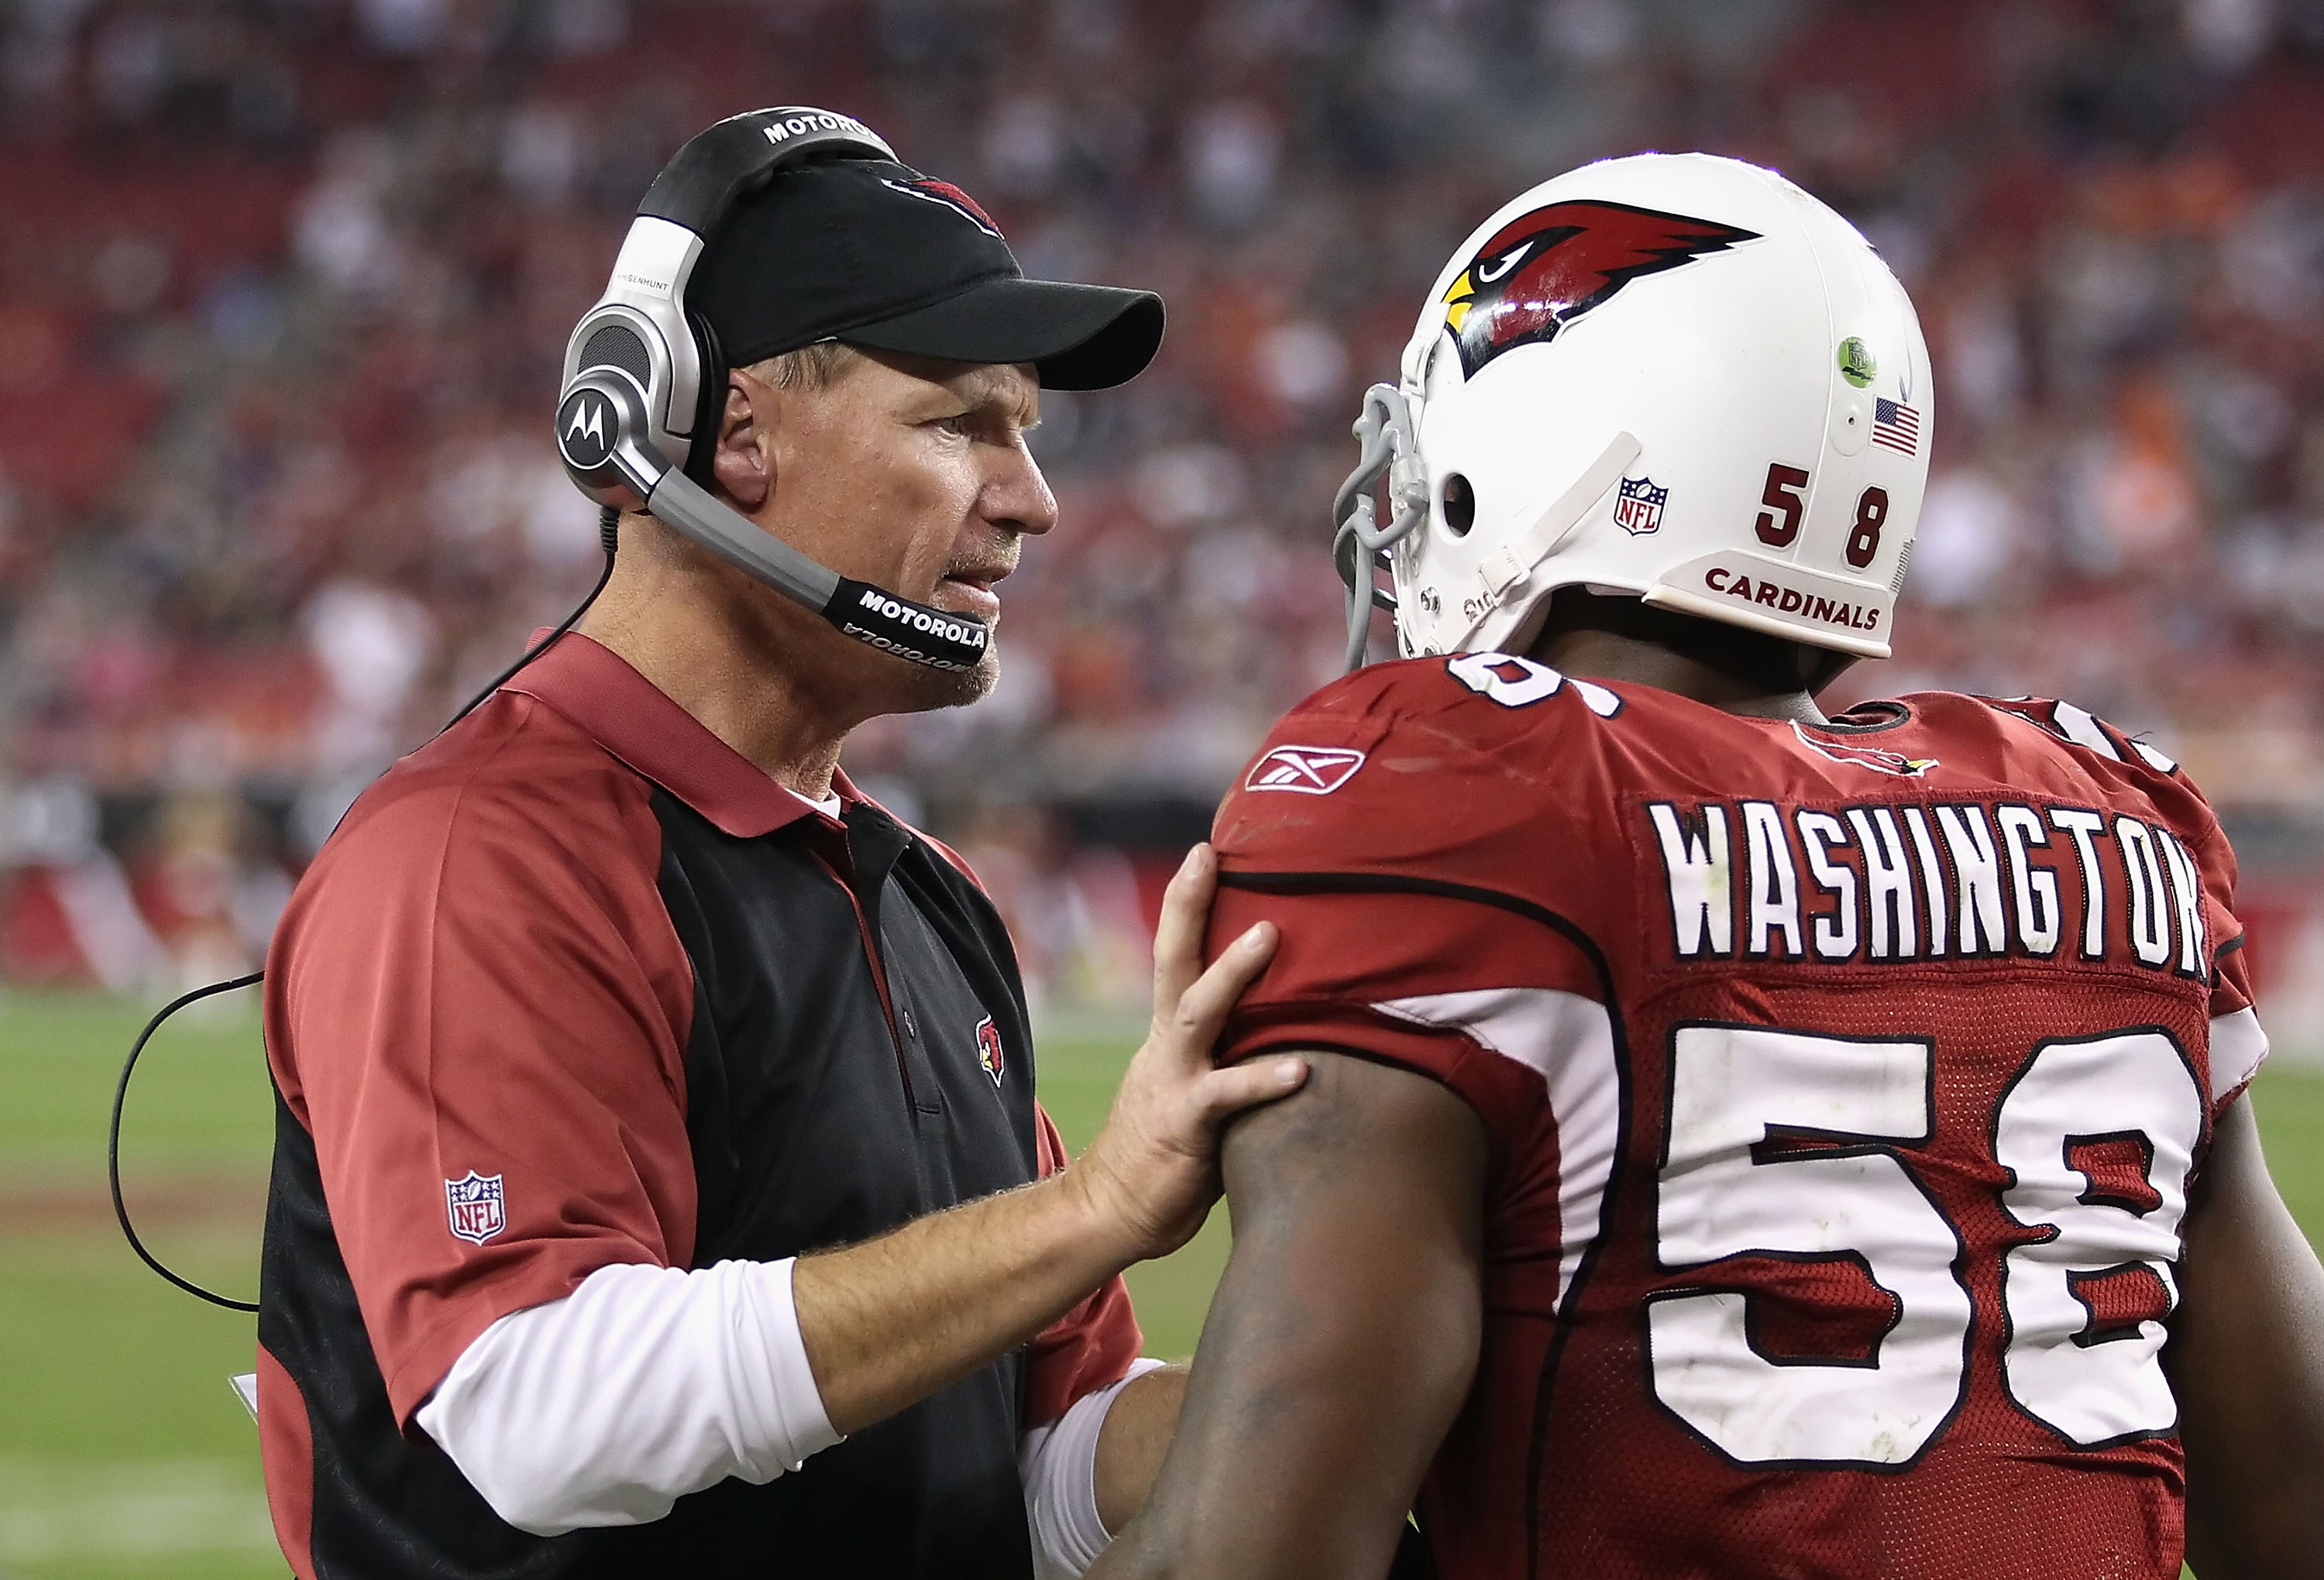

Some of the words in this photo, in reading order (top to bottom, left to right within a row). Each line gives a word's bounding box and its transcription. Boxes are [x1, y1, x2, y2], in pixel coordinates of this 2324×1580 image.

[1618, 498, 1655, 531] NFL
[1755, 462, 1810, 548] 5
[1846, 486, 1889, 568] 8
[859, 590, 985, 648] MOTOROLA
[1705, 568, 1880, 631] CARDINALS
[1648, 801, 2208, 980] WASHINGTON
[456, 1203, 498, 1232] NFL
[1642, 1022, 2205, 1472] 58
